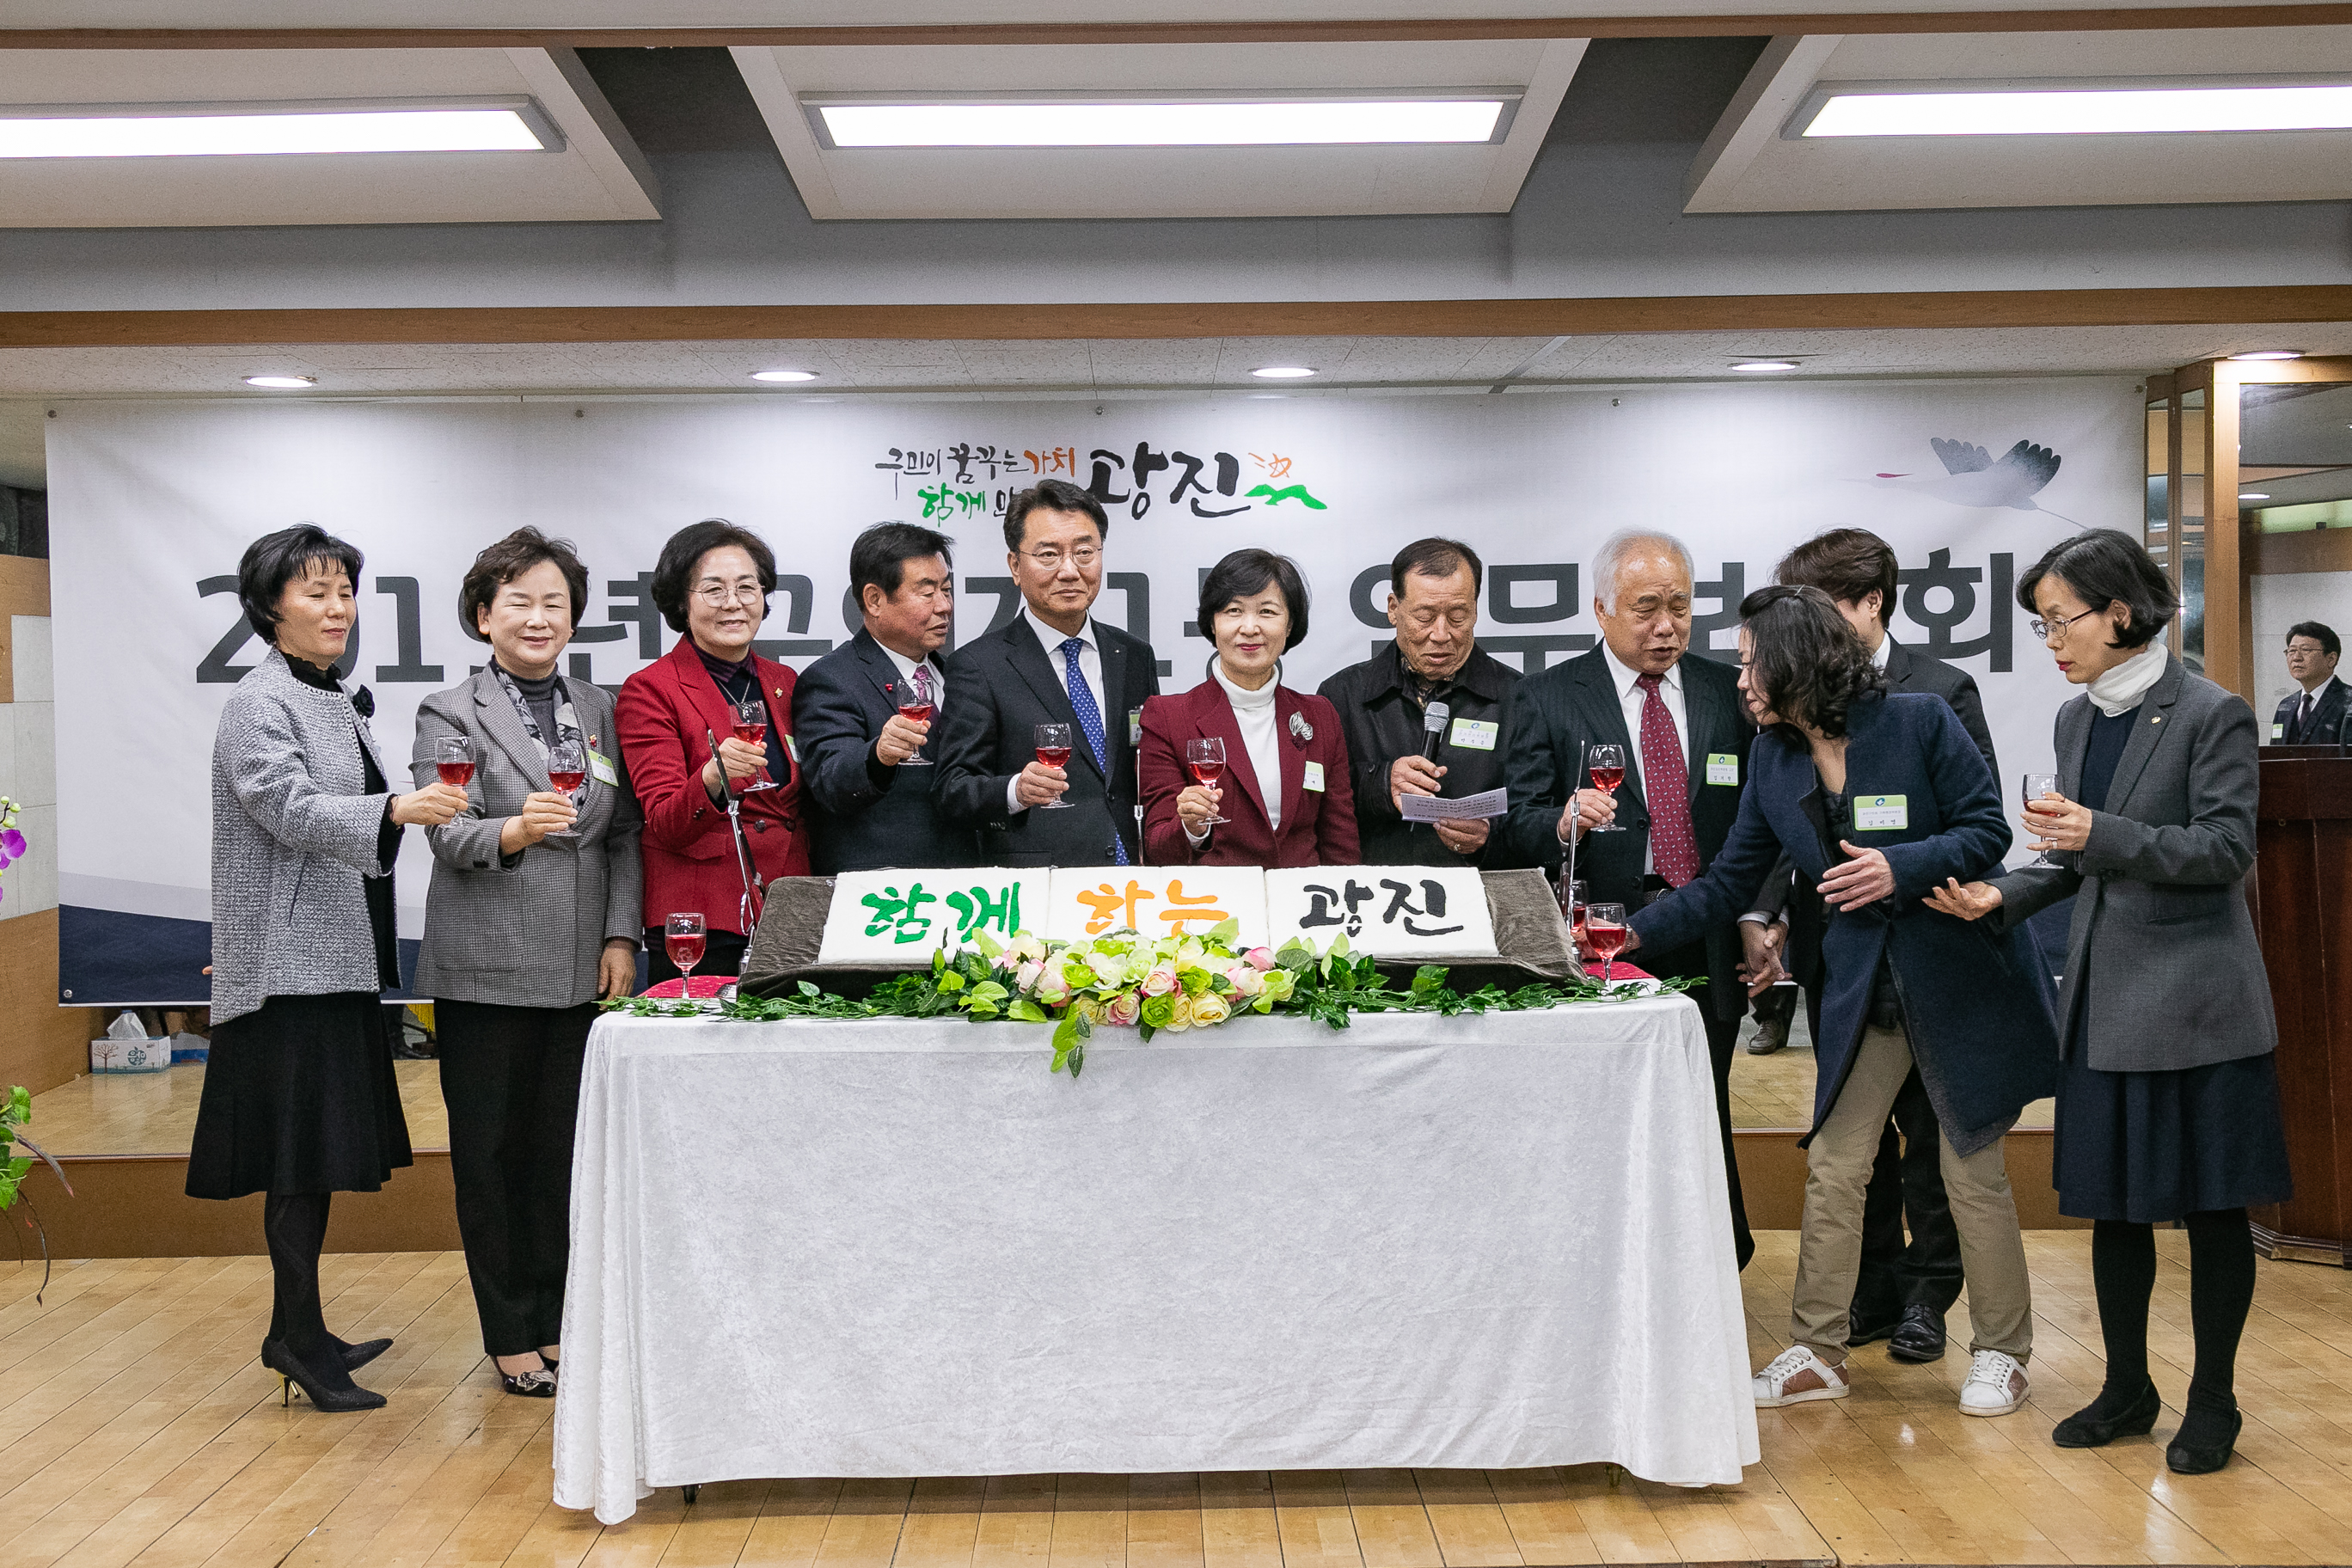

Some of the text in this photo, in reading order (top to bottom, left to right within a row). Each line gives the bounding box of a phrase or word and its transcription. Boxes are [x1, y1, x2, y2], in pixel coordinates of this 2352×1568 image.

[875, 443, 1075, 500] 구민이 꿈꾸는 가치
[1086, 441, 1252, 520] 광진
[918, 482, 987, 527] 함께
[861, 879, 1464, 944] 함께 하는 광진
